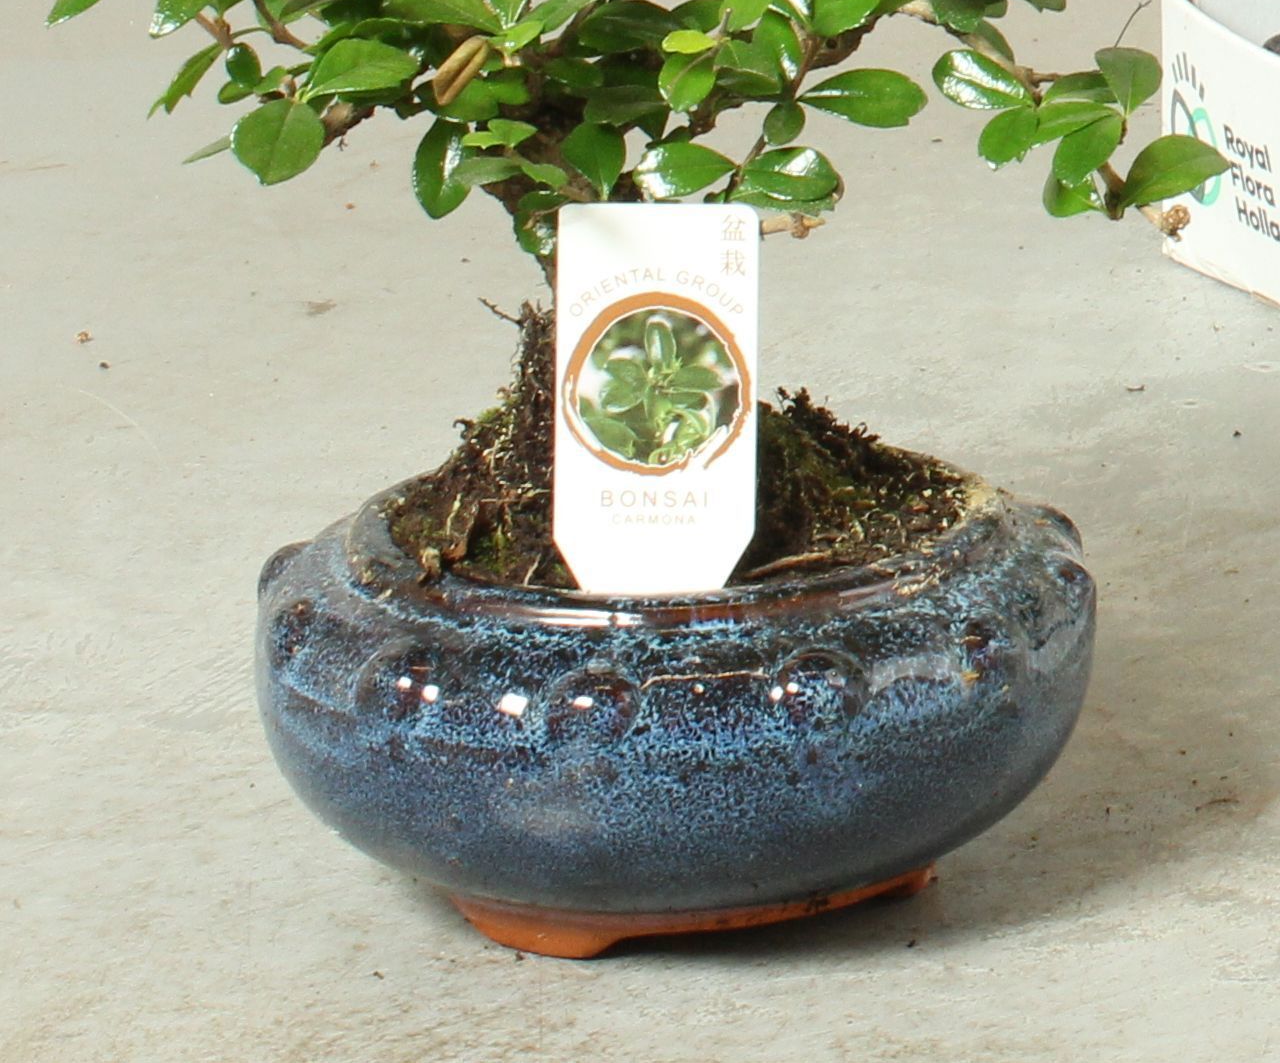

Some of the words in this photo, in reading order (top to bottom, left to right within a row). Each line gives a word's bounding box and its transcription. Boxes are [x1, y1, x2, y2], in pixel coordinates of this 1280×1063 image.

[1224, 124, 1272, 173] Royal
[1230, 161, 1276, 207] Flora
[721, 214, 747, 277] 盆栽
[569, 267, 665, 317] ORIENTAL
[676, 270, 744, 316] GROUP
[600, 490, 708, 507] BONSAI
[612, 514, 696, 525] CARMONA
